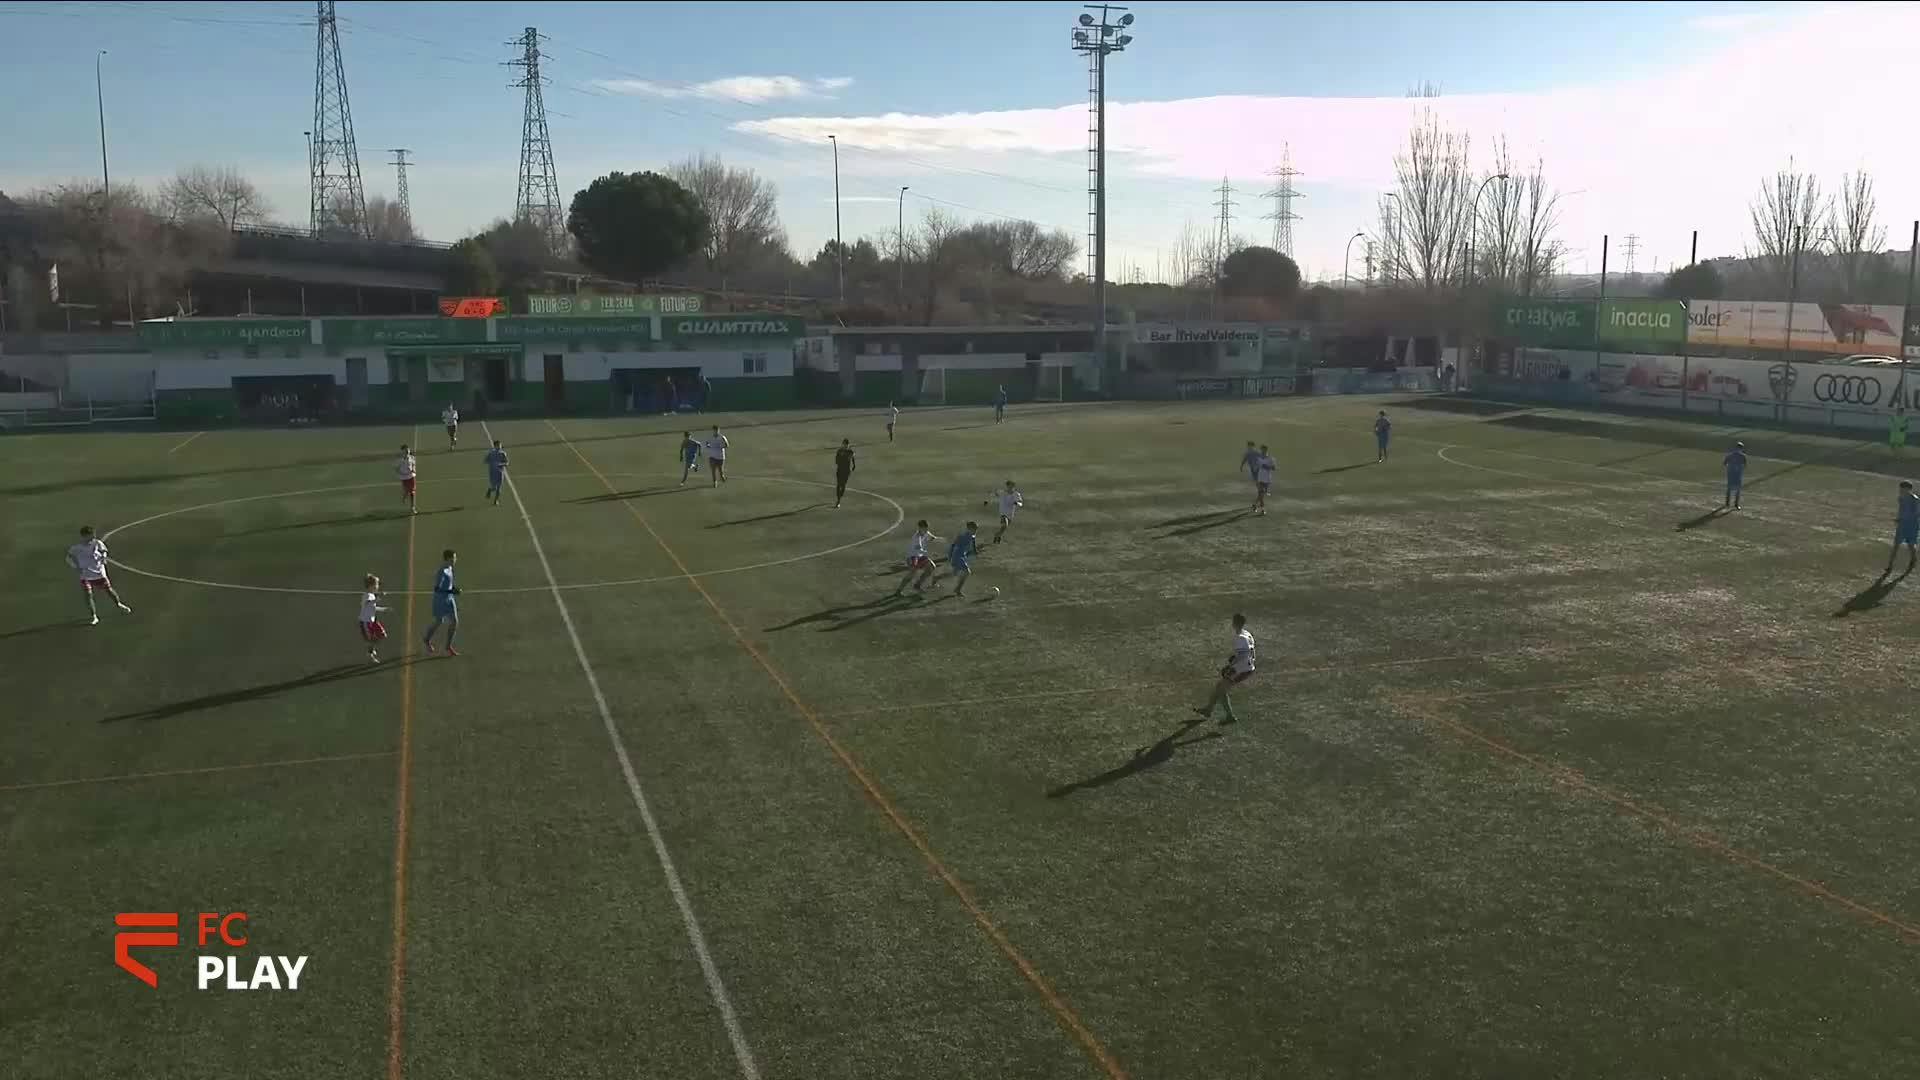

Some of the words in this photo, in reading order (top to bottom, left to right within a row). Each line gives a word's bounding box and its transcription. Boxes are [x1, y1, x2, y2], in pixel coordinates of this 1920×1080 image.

[1610, 307, 1671, 328] inacua
[678, 321, 789, 334] QUAMTRAX
[1151, 331, 1172, 341] Bar
